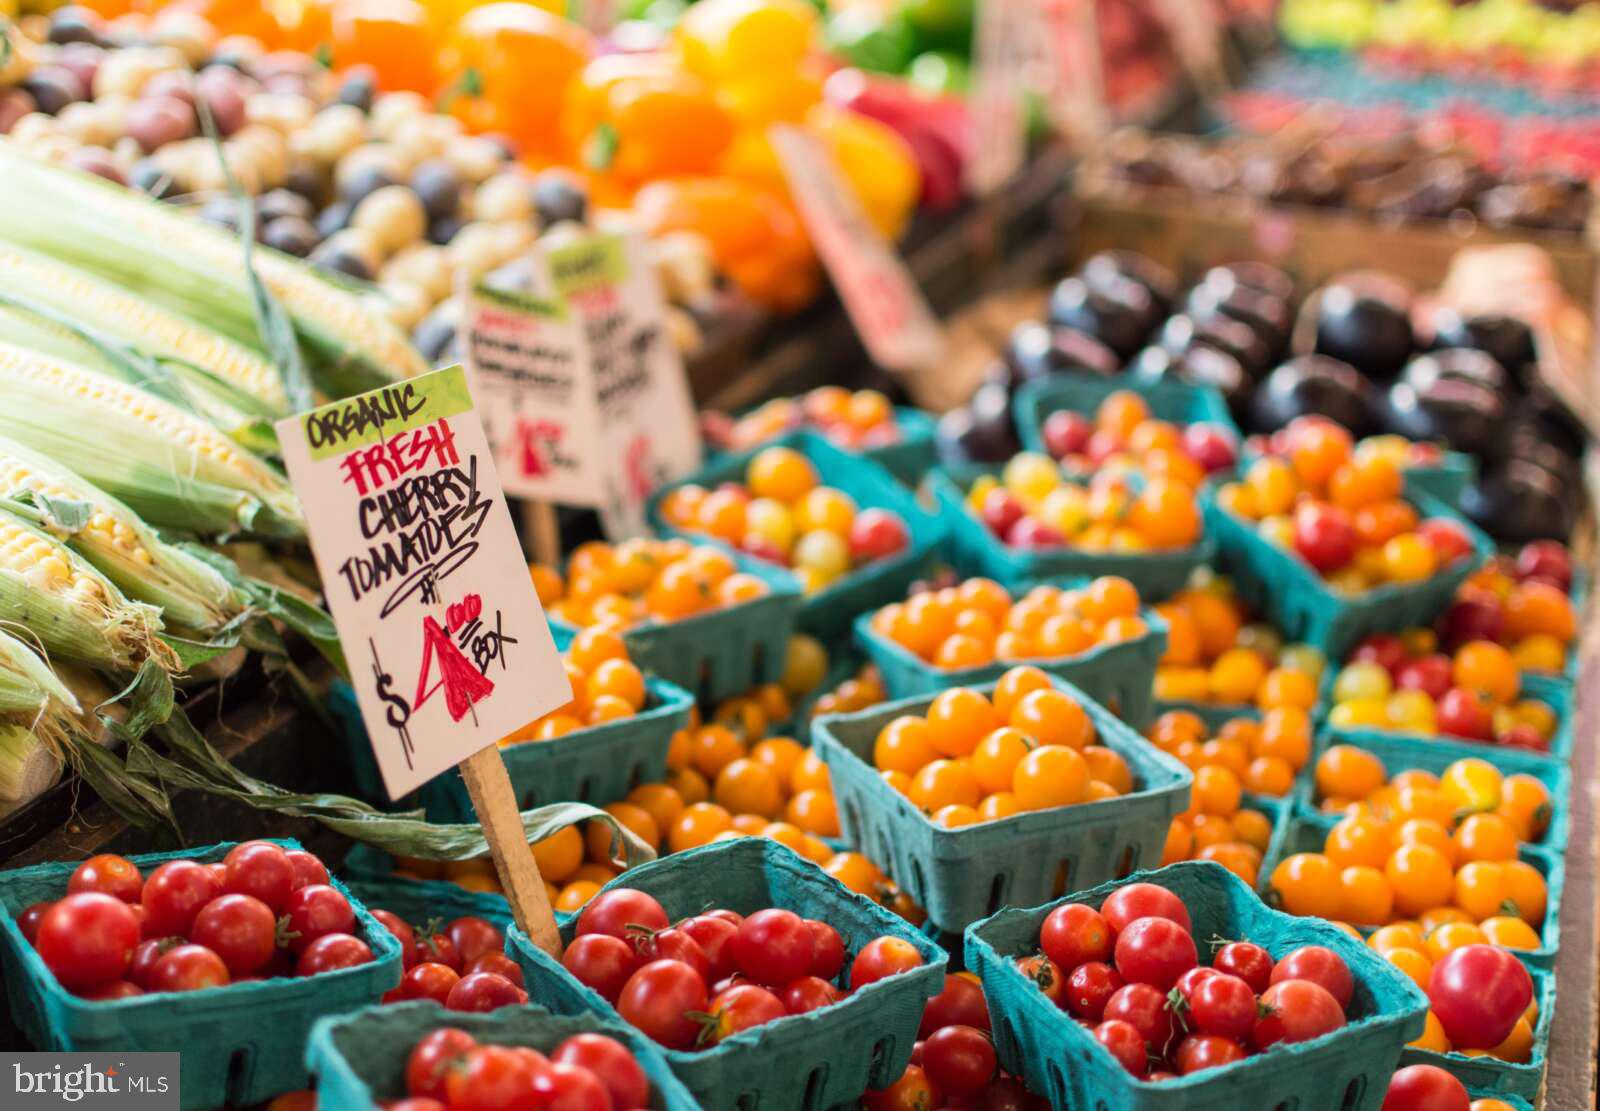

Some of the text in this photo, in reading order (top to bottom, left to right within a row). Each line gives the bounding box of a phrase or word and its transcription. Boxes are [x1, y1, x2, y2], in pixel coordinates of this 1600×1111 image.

[306, 383, 428, 450] ORGANIC
[339, 416, 461, 497] FRESH
[357, 455, 482, 540] CHERRY
[338, 495, 494, 602] TOMATOES
[470, 609, 518, 676] BOX
